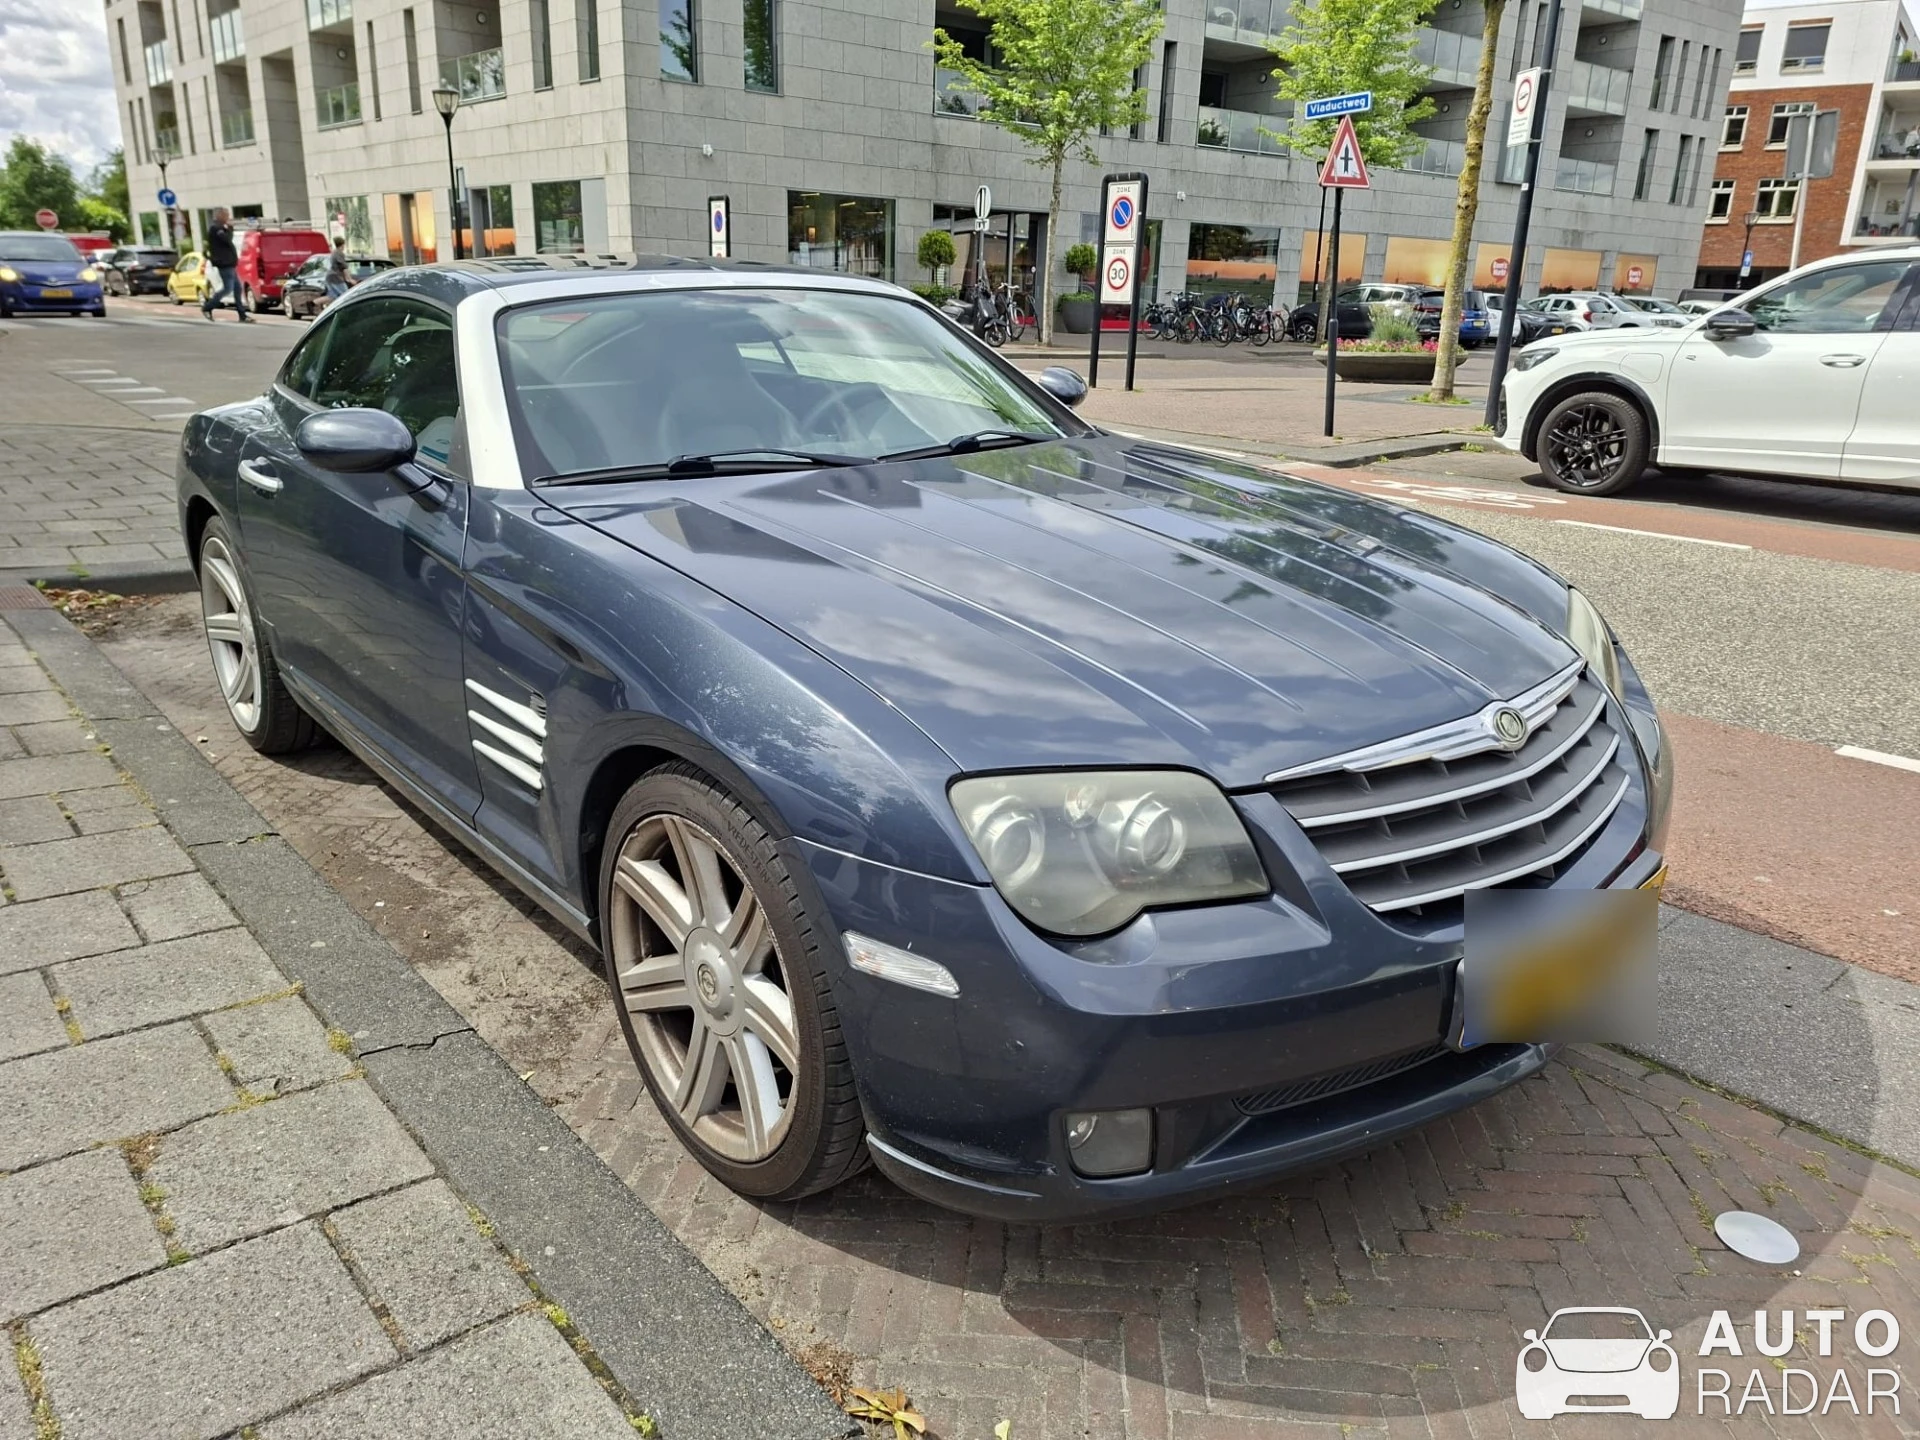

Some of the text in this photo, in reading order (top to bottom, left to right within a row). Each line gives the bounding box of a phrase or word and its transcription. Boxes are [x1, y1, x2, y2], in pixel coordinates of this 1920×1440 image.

[1310, 97, 1366, 114] Viaductweg
[1111, 268, 1125, 280] 30
[726, 820, 770, 884] VREDESTEIN
